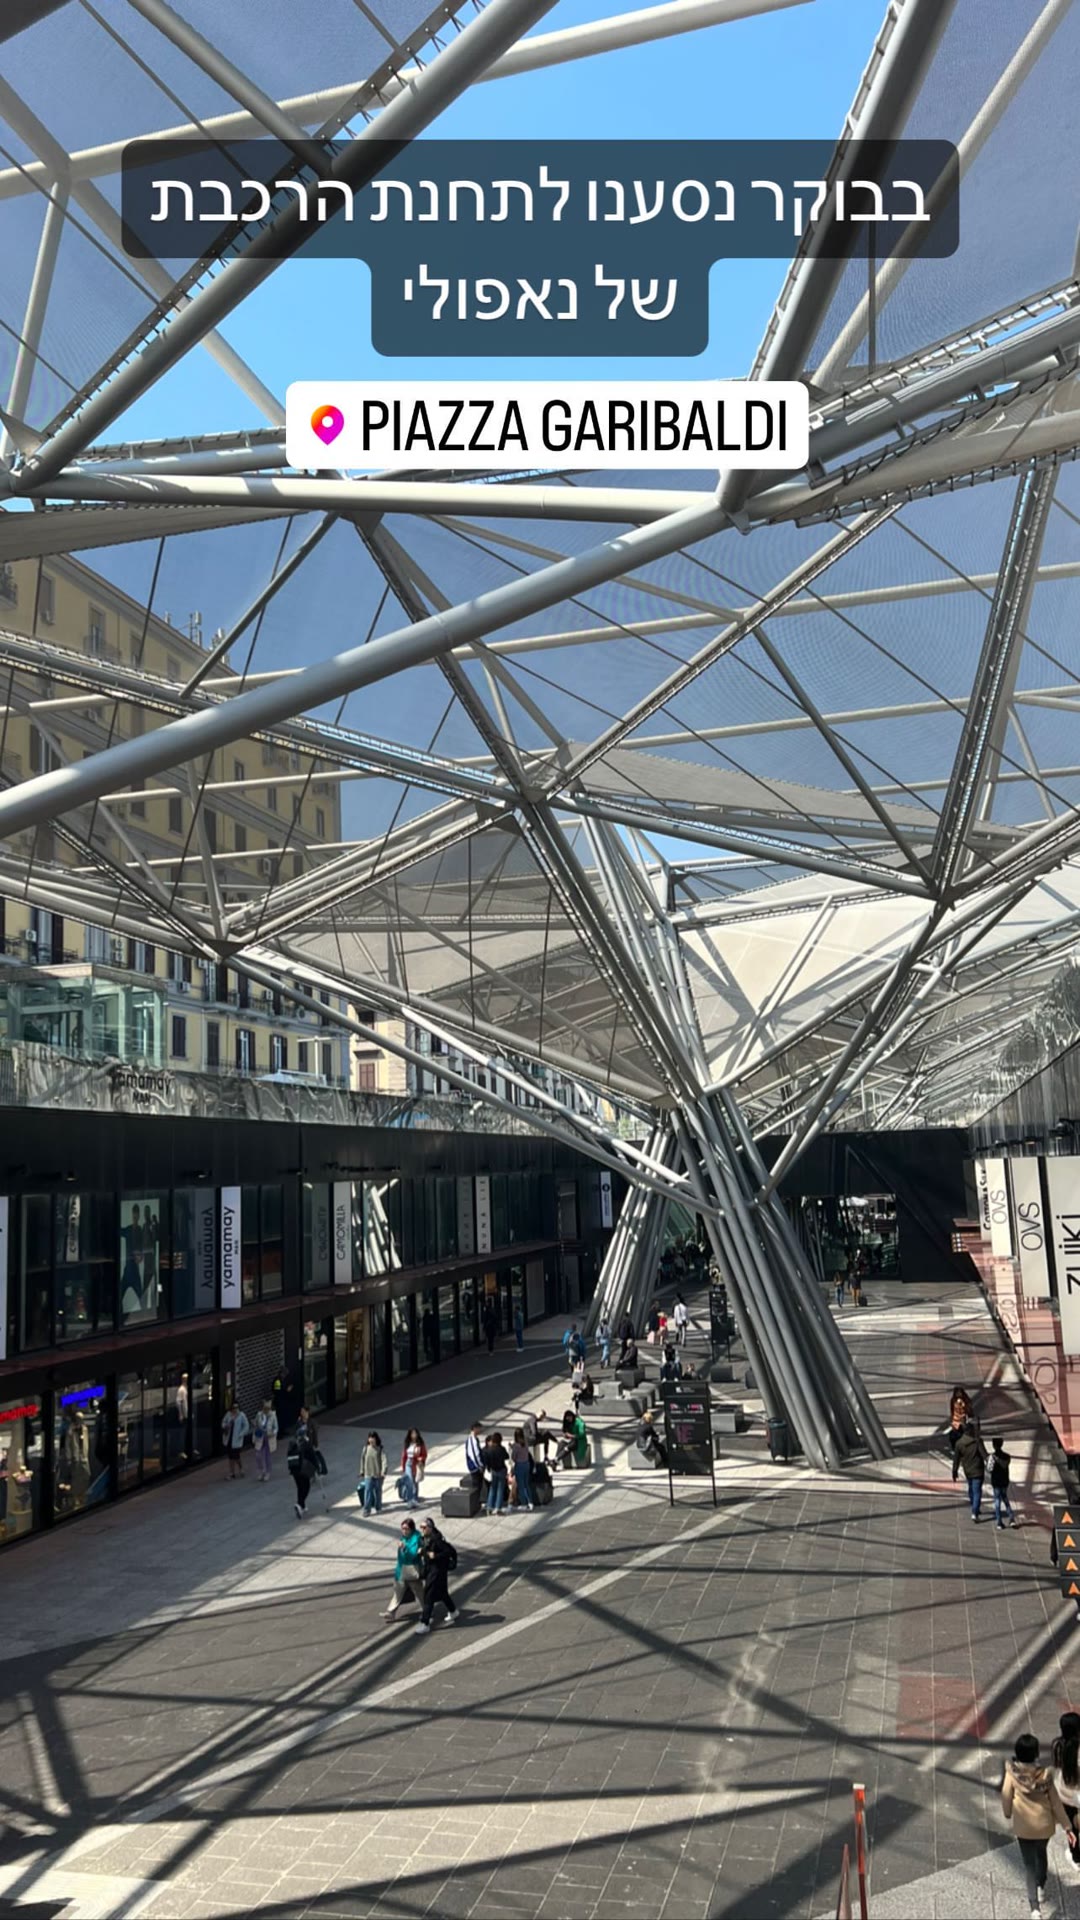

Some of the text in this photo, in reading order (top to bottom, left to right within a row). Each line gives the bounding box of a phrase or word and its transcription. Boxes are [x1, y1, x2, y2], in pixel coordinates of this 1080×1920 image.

[336, 1204, 346, 1261] CAMOMILLA
[990, 1189, 1007, 1225] OVS
[1018, 1202, 1043, 1251] OVS
[223, 1206, 235, 1289] yamamay
